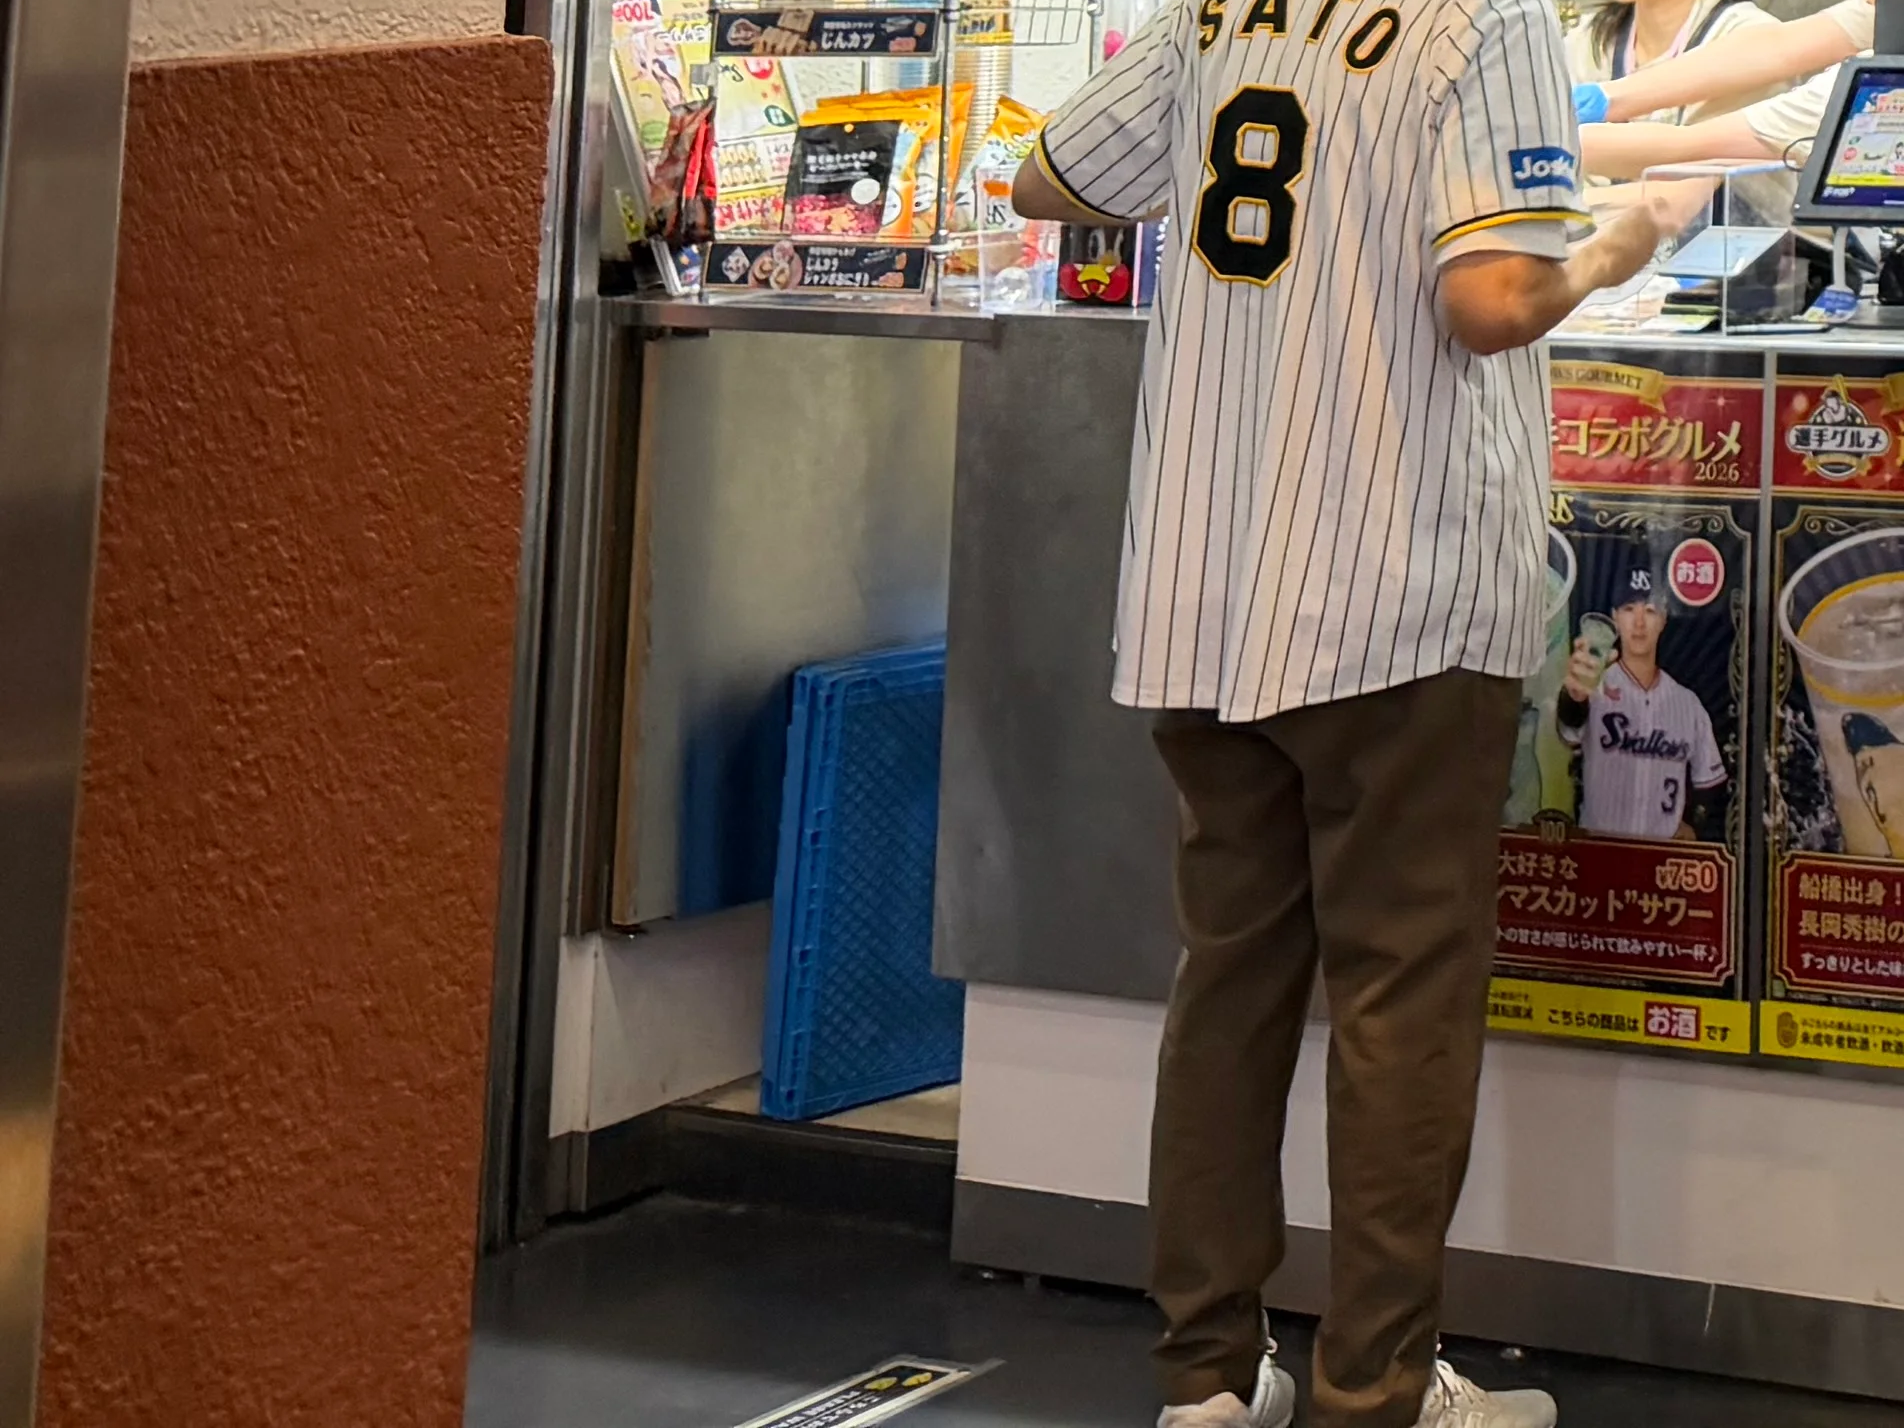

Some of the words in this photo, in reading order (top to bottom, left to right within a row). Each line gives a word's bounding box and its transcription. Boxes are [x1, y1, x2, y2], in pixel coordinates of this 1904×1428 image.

[1193, 84, 1311, 288] 8
[1577, 370, 1643, 389] GOURMET
[1795, 427, 1882, 449] 選手グルメ
[1695, 462, 1739, 481] 2026
[1678, 562, 1716, 585] お酒
[1601, 713, 1690, 760] Swallows
[1662, 779, 1679, 814] 3
[1499, 852, 1577, 879] 大好きな
[1656, 859, 1717, 891] ¥750
[1800, 873, 1902, 906] 船橋出身！
[1548, 1009, 1639, 1031] こちらの商品は
[1647, 1007, 1696, 1038] お酒
[1705, 1025, 1731, 1042] です
